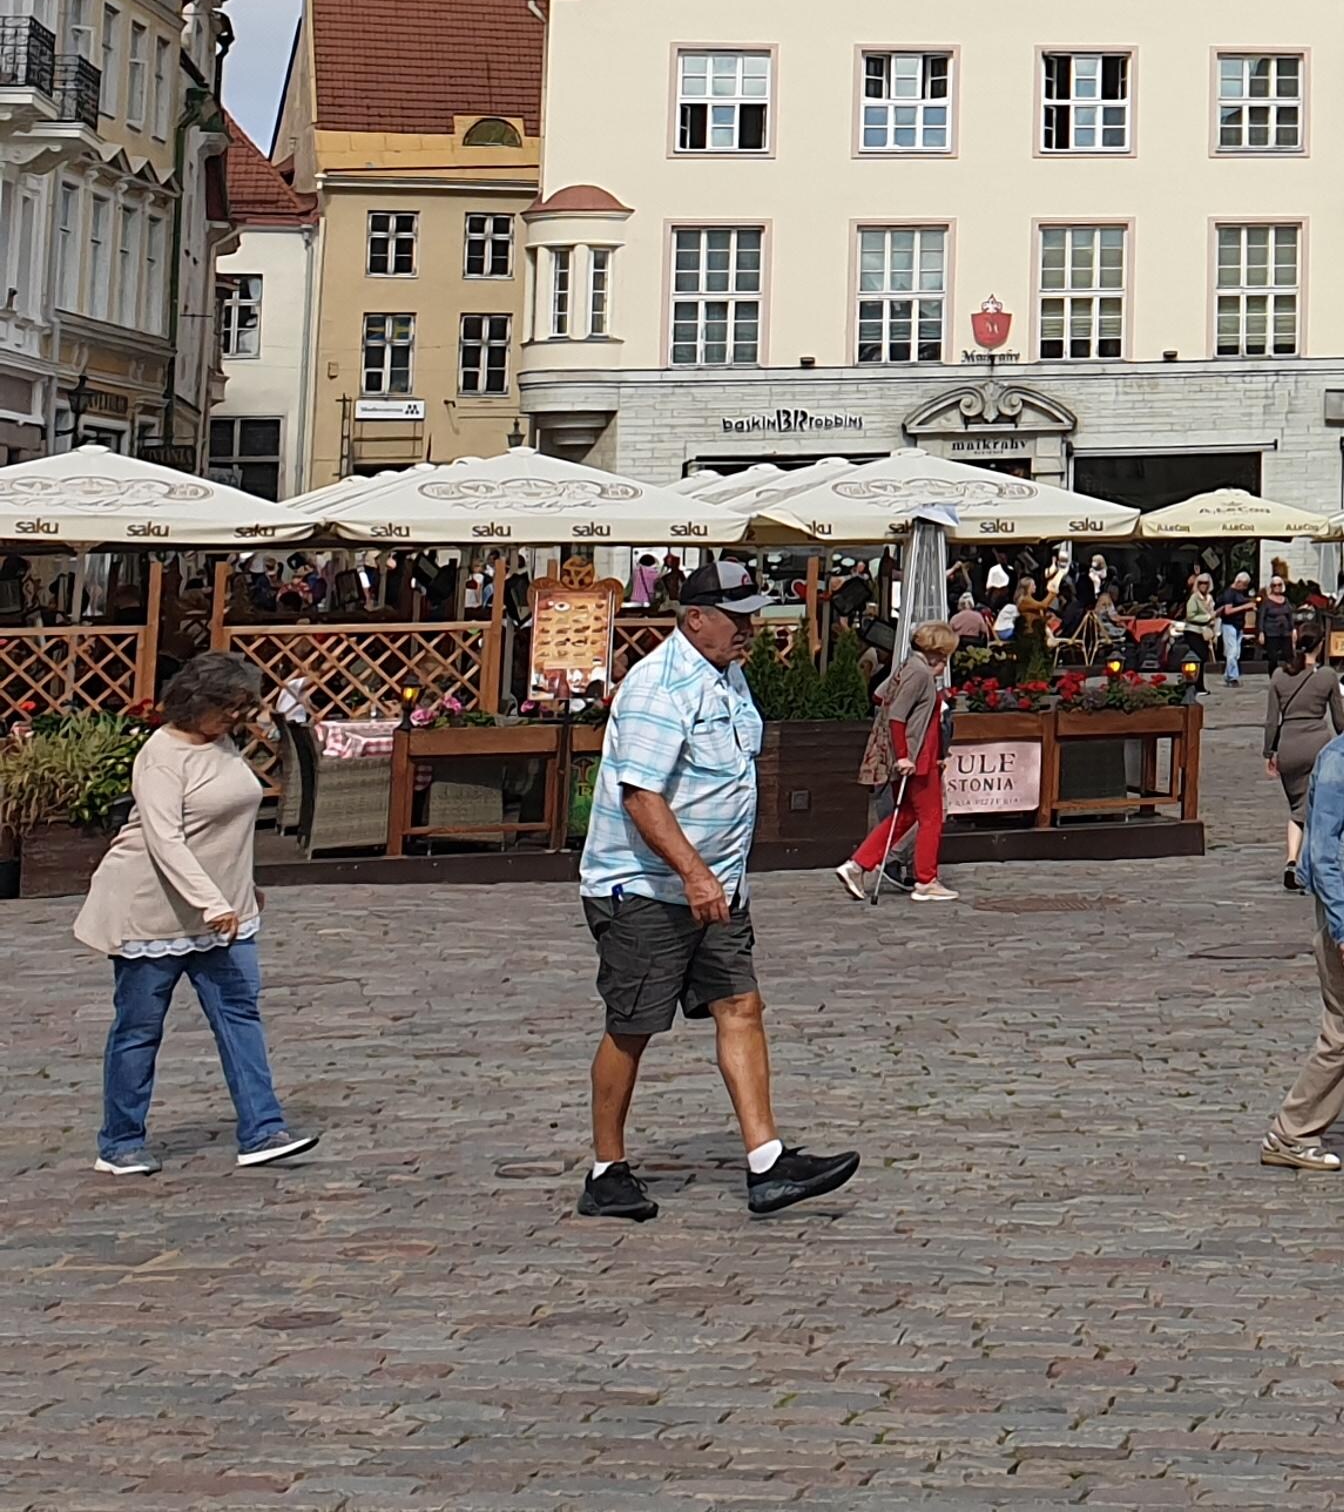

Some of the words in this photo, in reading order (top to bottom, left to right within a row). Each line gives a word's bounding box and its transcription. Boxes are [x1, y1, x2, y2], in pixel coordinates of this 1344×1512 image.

[15, 518, 59, 535] saku
[127, 521, 170, 537] saku
[233, 524, 277, 539] saku
[370, 522, 410, 538] saku
[472, 522, 512, 537] saku
[572, 522, 611, 537] saku
[670, 521, 708, 536] saku
[979, 518, 1015, 534] saku
[1068, 517, 1103, 532] saku
[957, 753, 1016, 775] ULE
[947, 778, 1014, 792] STONIA
